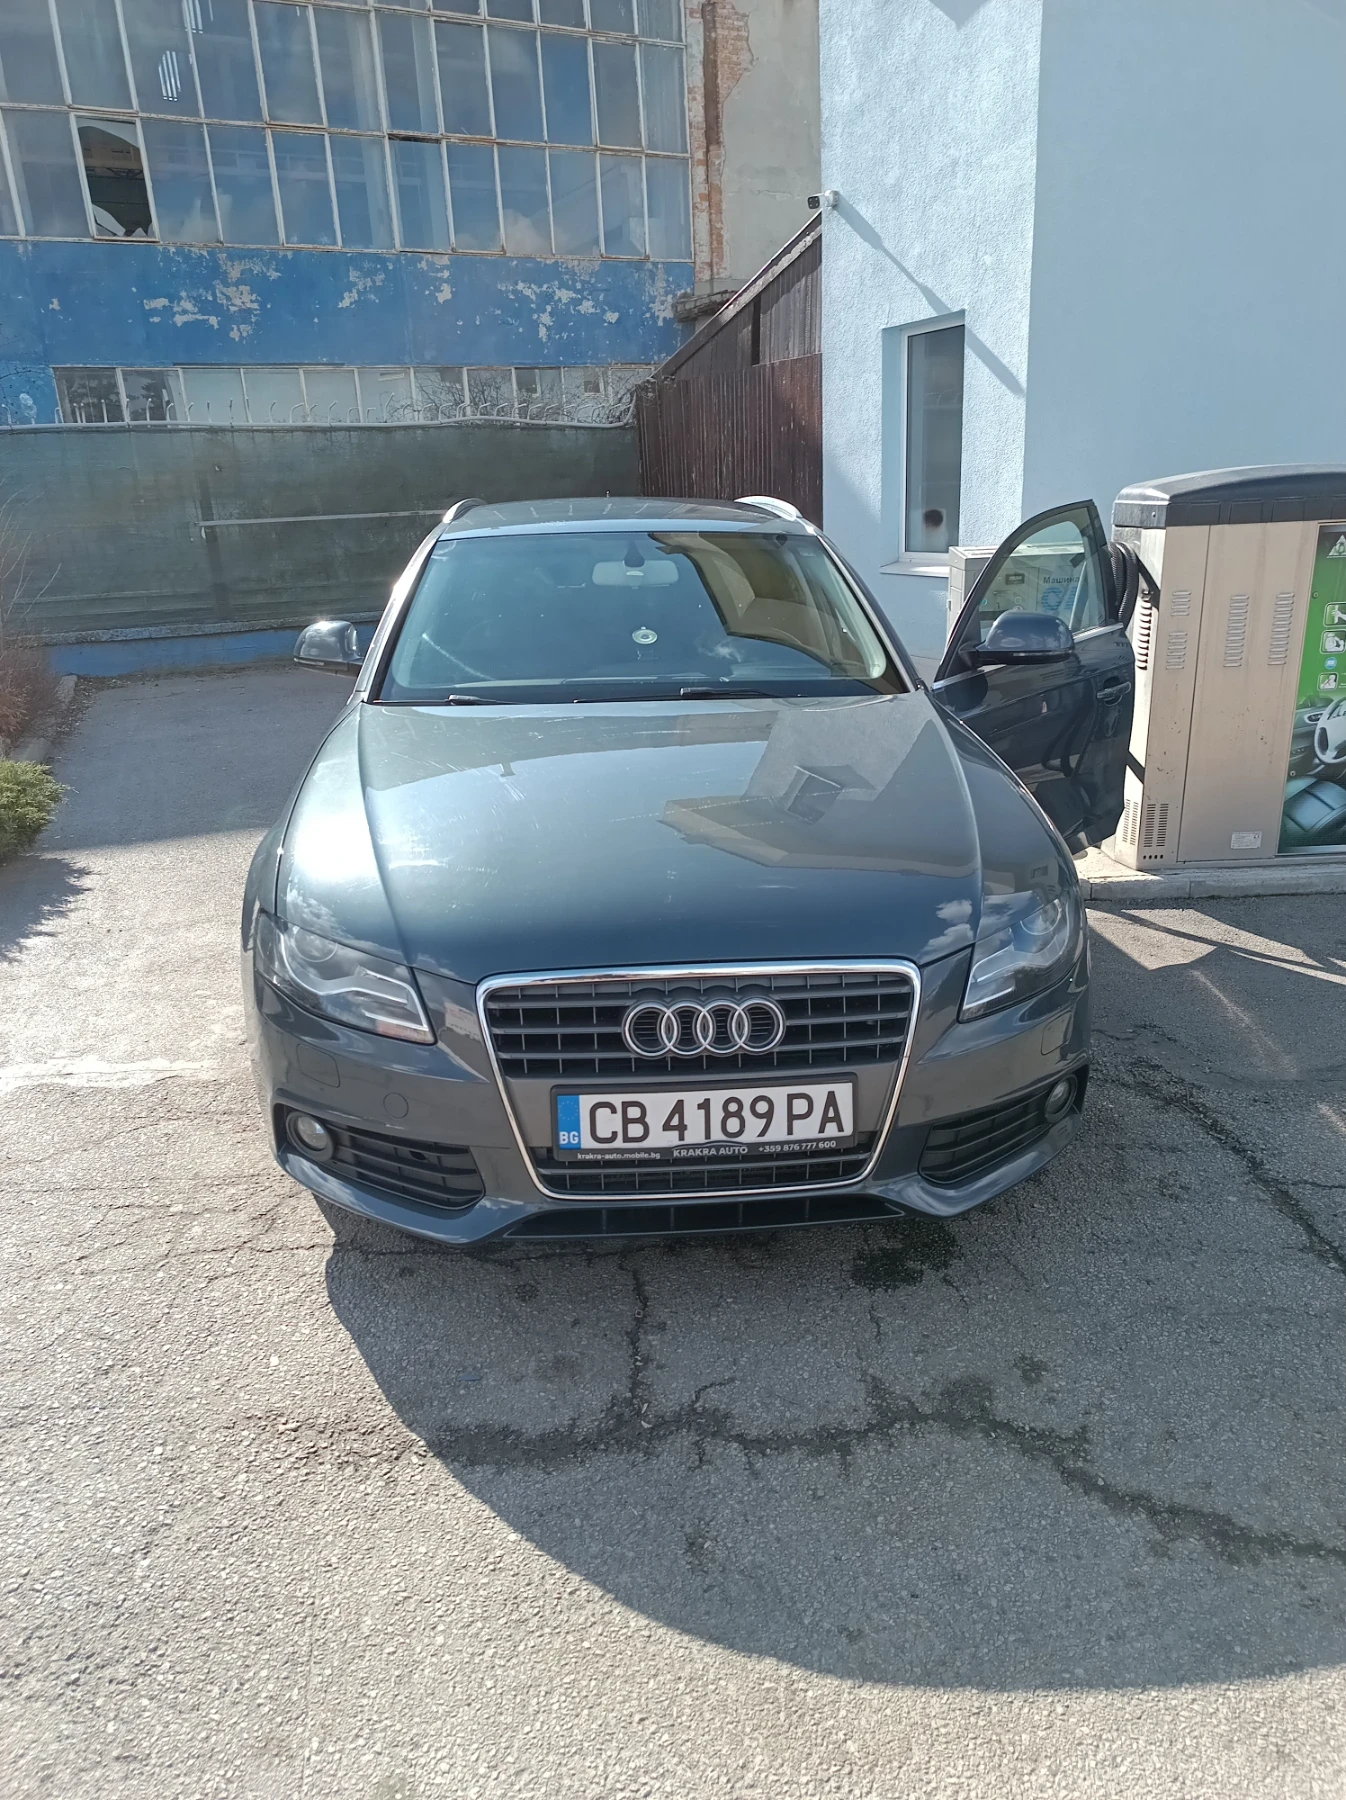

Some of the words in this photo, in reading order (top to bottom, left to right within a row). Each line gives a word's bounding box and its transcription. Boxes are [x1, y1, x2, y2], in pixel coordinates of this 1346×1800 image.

[1043, 576, 1080, 584] Машина
[589, 1101, 650, 1144] CB
[662, 1095, 775, 1142] 4189
[787, 1091, 845, 1135] PA
[560, 1131, 579, 1144] BG
[673, 1148, 718, 1158] KRAKRA
[719, 1146, 748, 1156] AUTO
[758, 1145, 781, 1153] +359
[783, 1143, 800, 1151] 876
[801, 1142, 817, 1150] 777
[818, 1140, 837, 1149] 600
[577, 1152, 661, 1160] krakra-auto.mobile.bg
